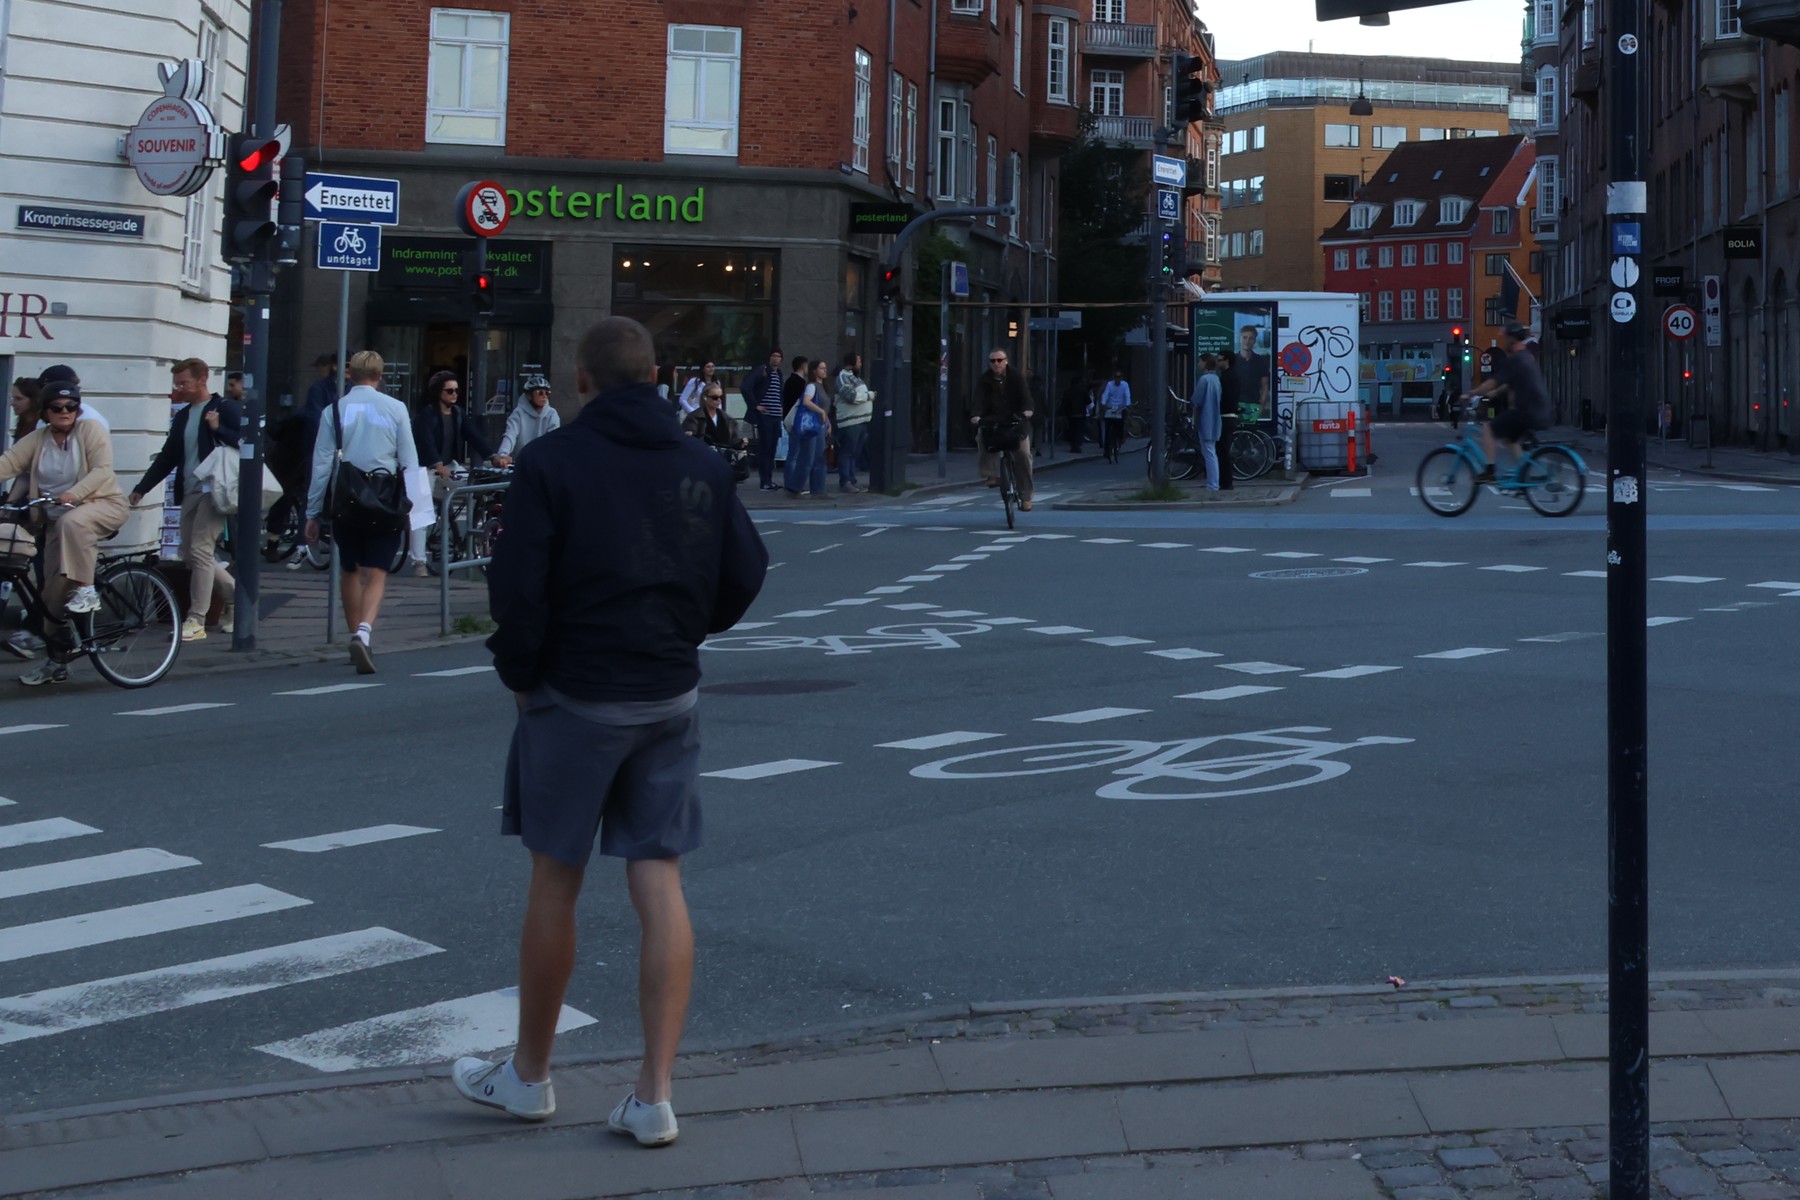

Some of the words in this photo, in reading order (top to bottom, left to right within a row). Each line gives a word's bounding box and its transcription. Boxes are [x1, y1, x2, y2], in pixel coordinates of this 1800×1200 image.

[137, 138, 196, 153] SOUVENIR
[320, 191, 391, 210] Ensrettet
[506, 184, 704, 222] osterland
[24, 210, 138, 232] Kronprinsessegade
[856, 213, 908, 223] posterland
[1727, 240, 1755, 248] BOLIA
[327, 255, 372, 266] undtaget
[1655, 276, 1681, 284] FROST
[1670, 317, 1692, 330] 40
